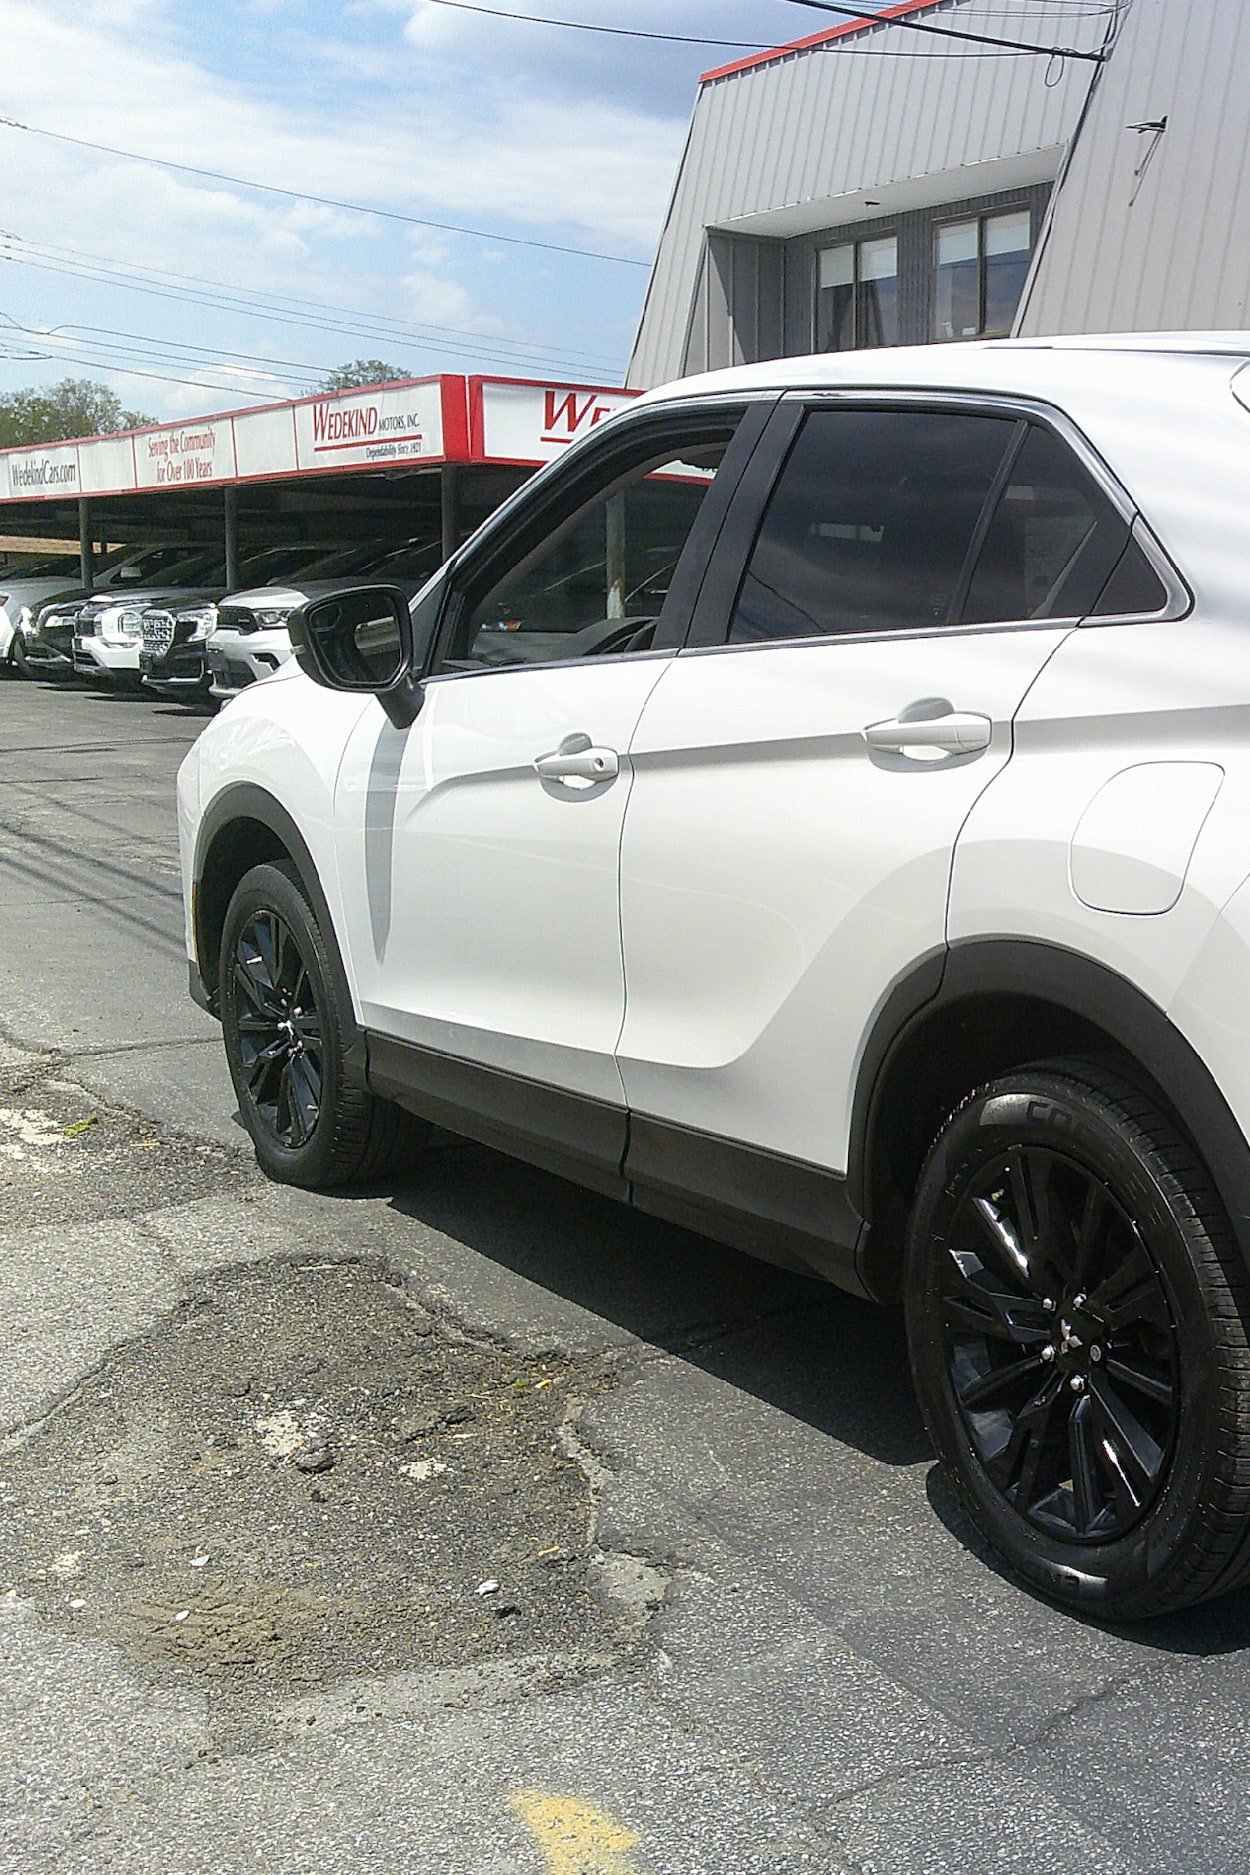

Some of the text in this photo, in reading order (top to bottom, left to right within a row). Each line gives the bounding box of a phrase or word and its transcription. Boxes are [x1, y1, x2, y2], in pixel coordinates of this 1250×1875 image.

[313, 402, 378, 442] WEDEKIND
[148, 425, 216, 462] Serving the Community
[12, 458, 76, 486] WedekindCars.com
[157, 456, 213, 483] for Over 100 Years
